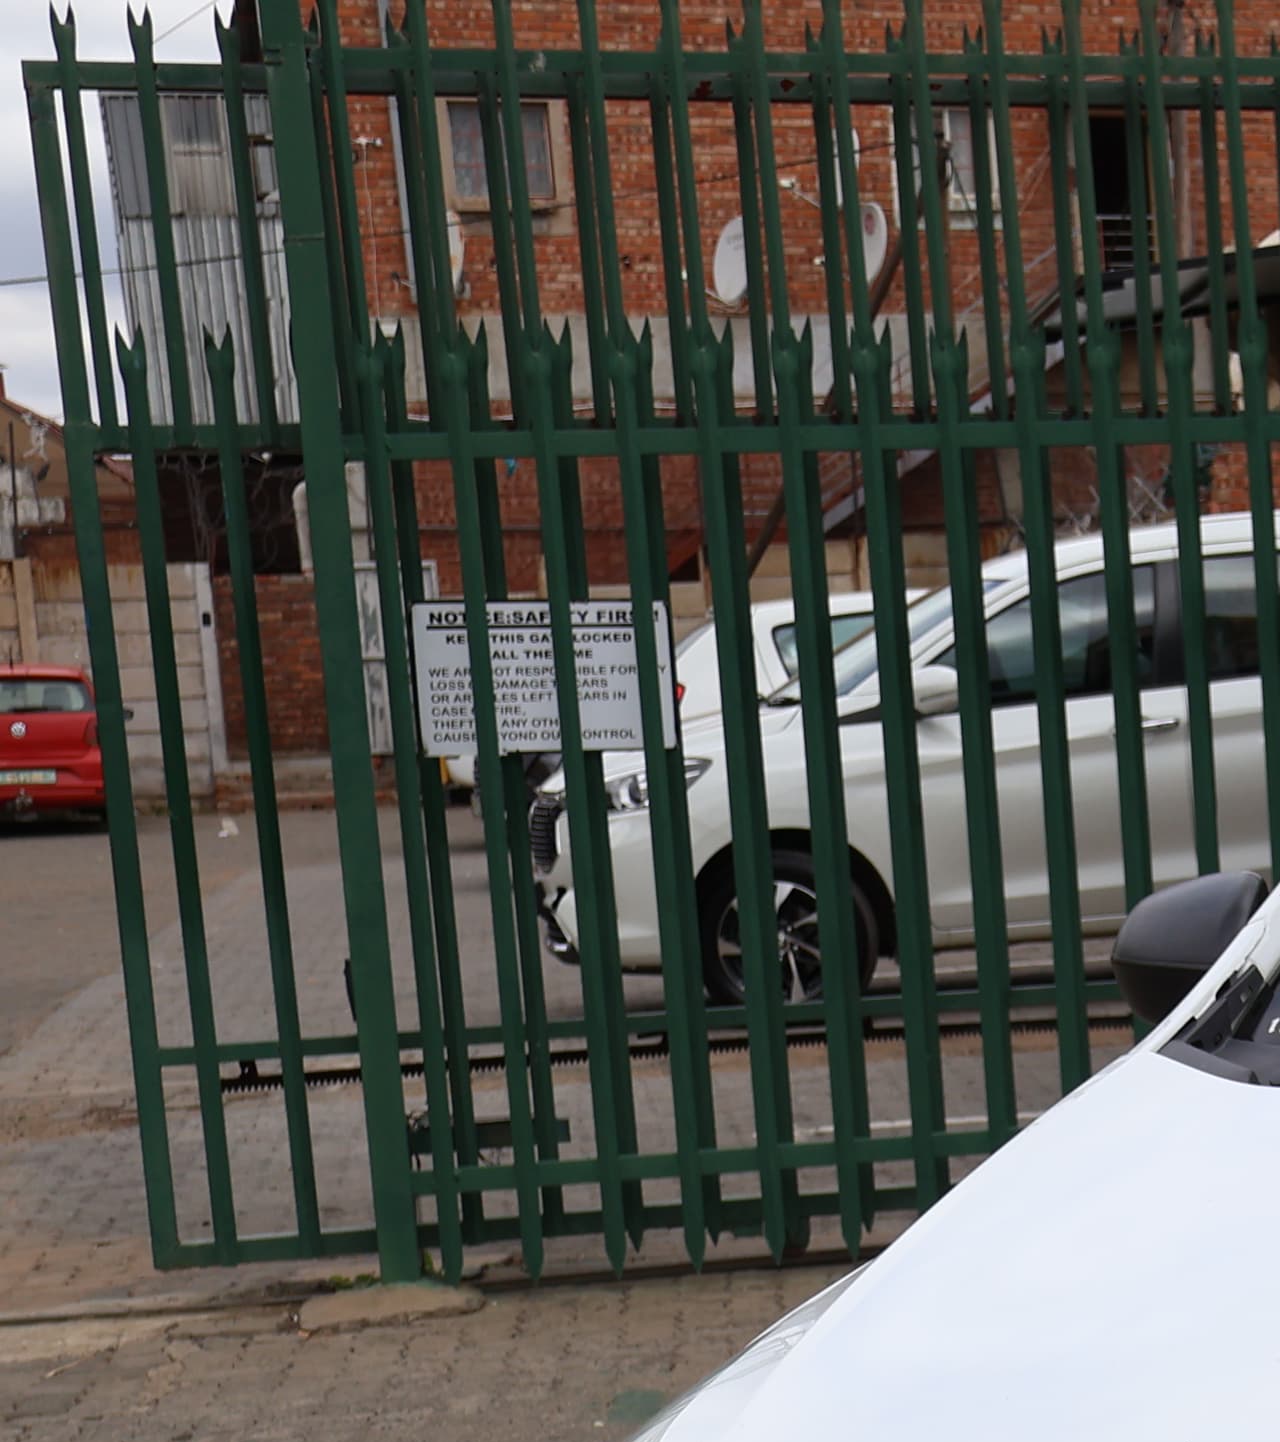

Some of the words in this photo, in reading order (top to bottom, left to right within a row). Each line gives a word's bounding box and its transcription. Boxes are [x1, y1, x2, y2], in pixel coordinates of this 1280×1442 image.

[491, 634, 525, 644] THIS
[572, 632, 632, 643] LOCKED
[492, 650, 518, 660] ALL
[524, 650, 553, 660] THE
[428, 667, 449, 678] WE
[430, 681, 465, 692] LOSS
[431, 693, 449, 705] OR
[522, 692, 553, 702] LEFT
[613, 690, 627, 700] IN
[432, 706, 467, 718] CASE
[433, 719, 474, 730] THEFT
[501, 718, 528, 728] ANY
[580, 728, 637, 740] ONTROL
